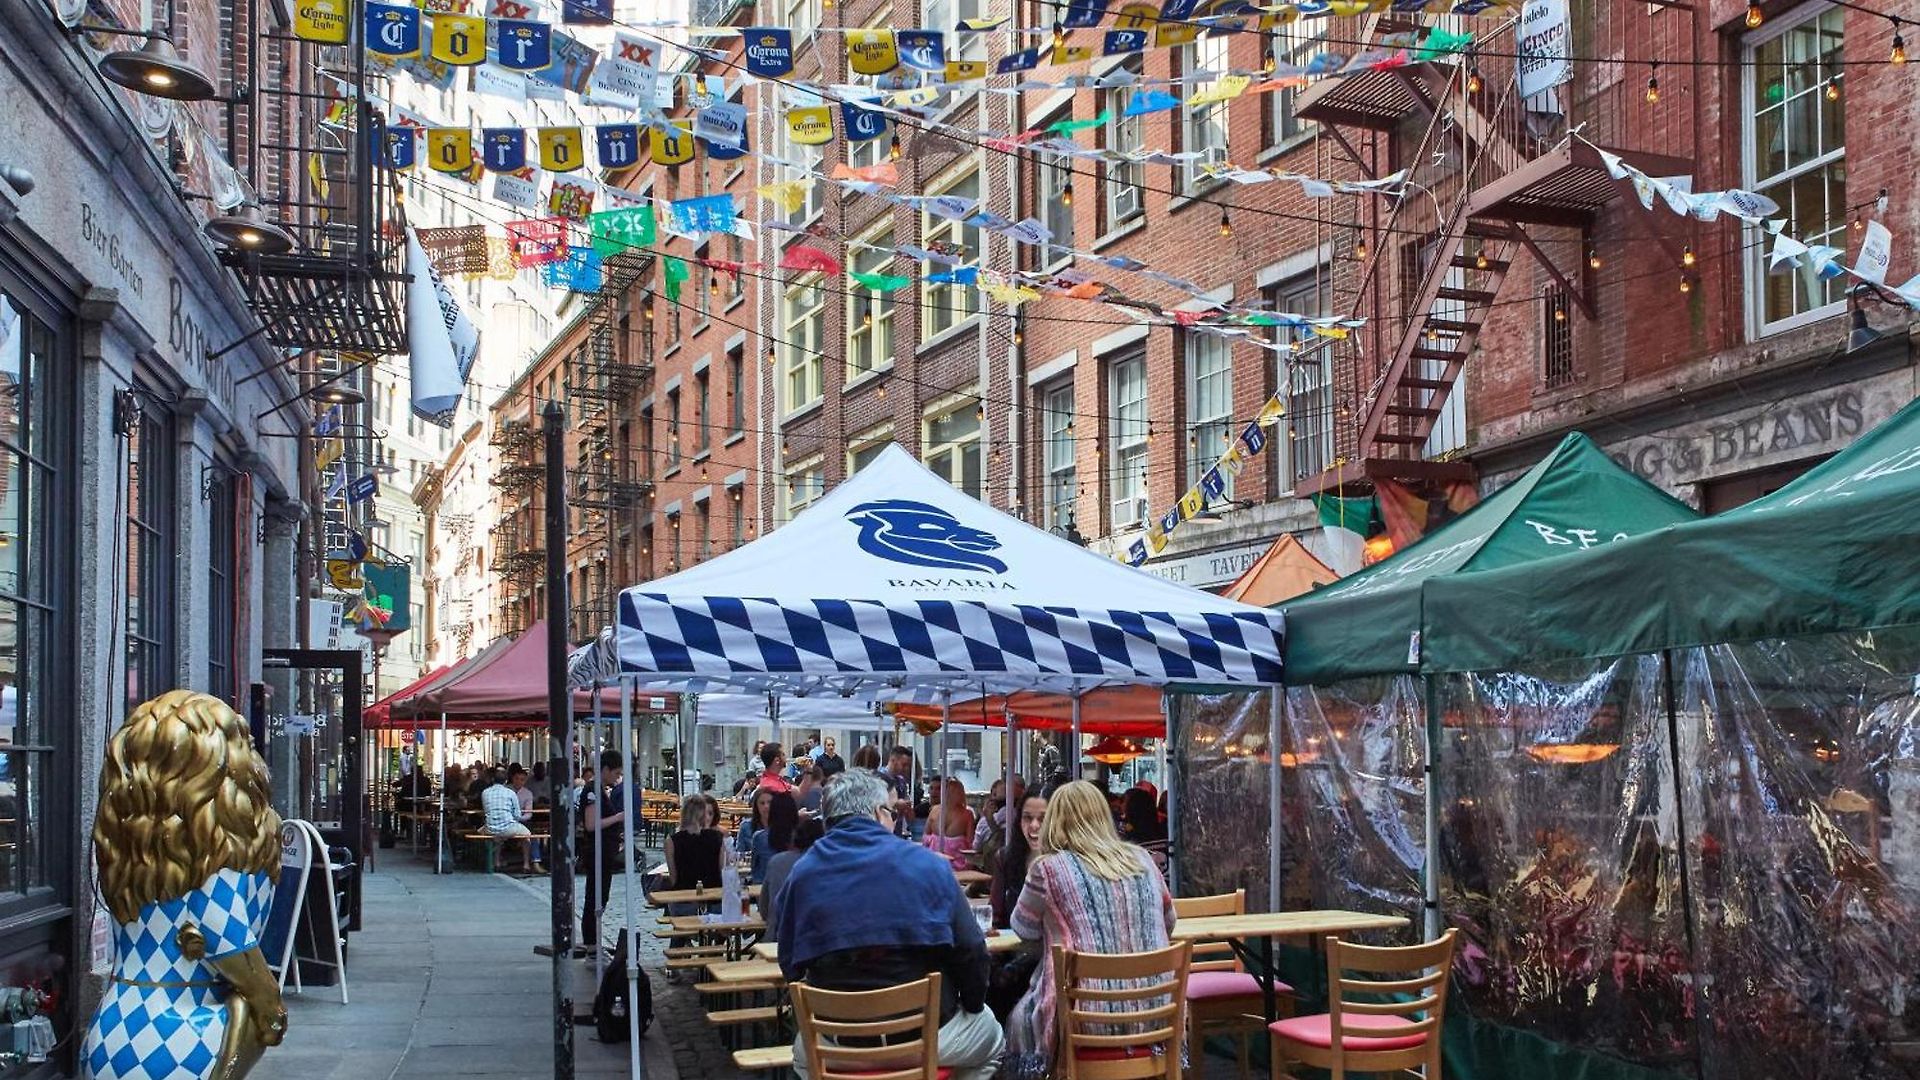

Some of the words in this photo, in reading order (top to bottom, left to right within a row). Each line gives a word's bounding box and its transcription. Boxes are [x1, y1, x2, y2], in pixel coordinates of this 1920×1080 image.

[300, 8, 345, 22] Corona
[312, 21, 335, 30] Light
[1523, 22, 1564, 53] CINCO
[618, 39, 655, 67] XX
[749, 45, 789, 57] Corona
[853, 41, 889, 53] Corona
[759, 57, 782, 66] Extra
[793, 120, 827, 132] Corona
[81, 202, 107, 257] Bier
[110, 233, 143, 300] Garten
[1668, 437, 1704, 475] &
[1709, 390, 1864, 466] BEANS
[888, 578, 1018, 591] BAVARIA
